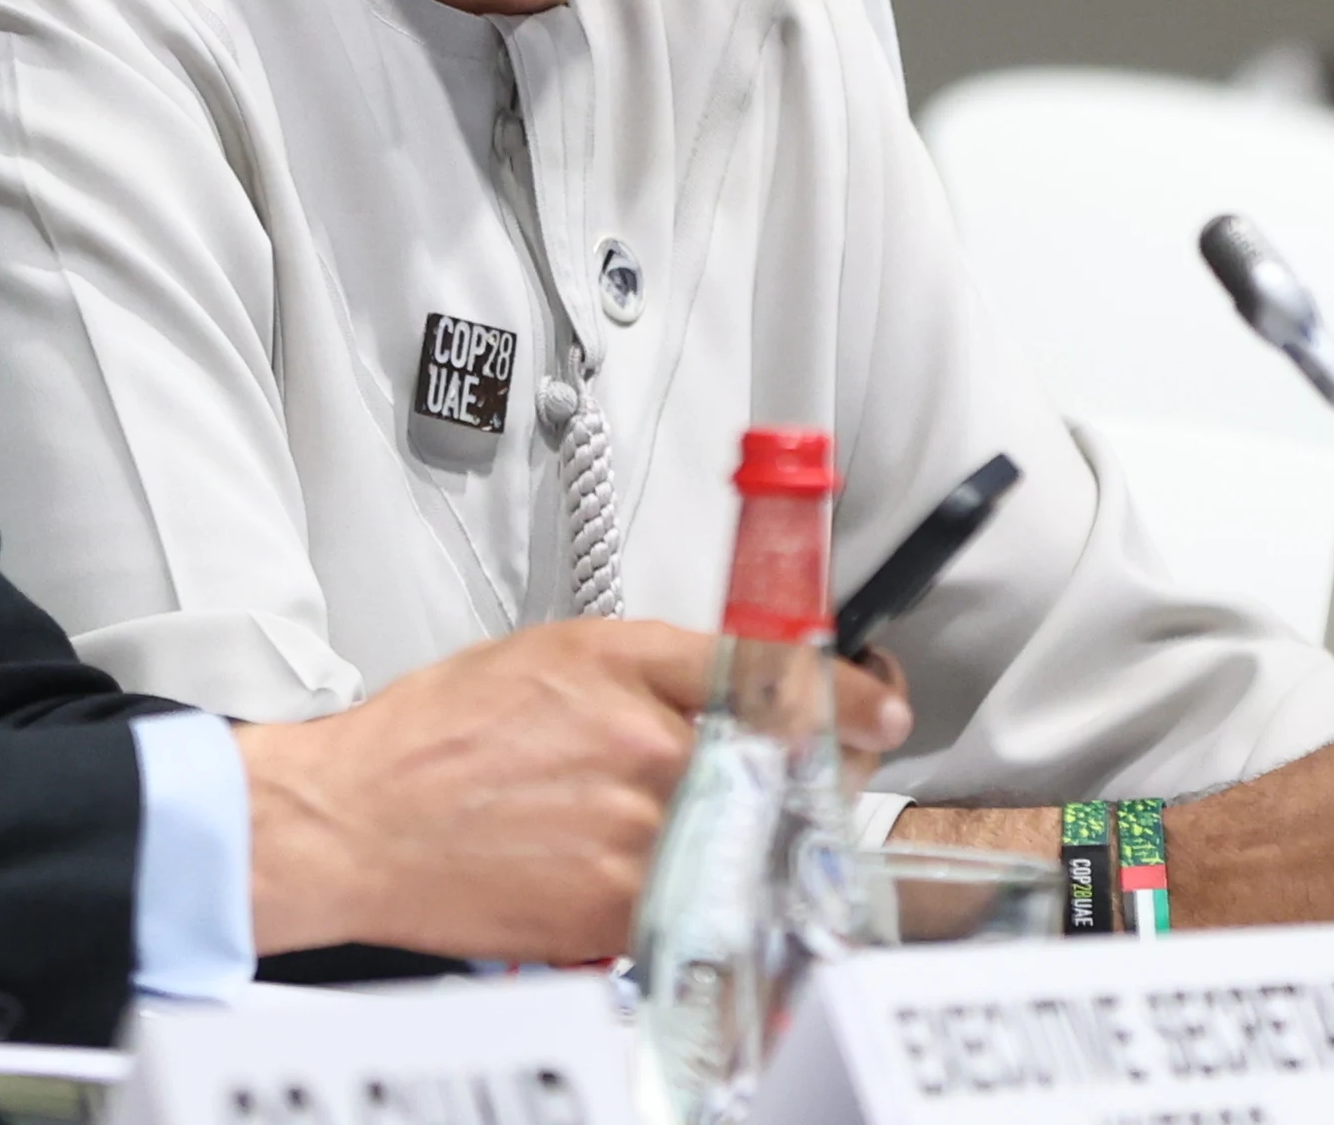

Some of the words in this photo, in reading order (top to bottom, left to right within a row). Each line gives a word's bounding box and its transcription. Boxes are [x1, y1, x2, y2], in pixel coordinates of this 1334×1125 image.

[435, 316, 513, 381] COP28
[427, 363, 480, 426] UAE
[1069, 858, 1094, 927] COP28UAE
